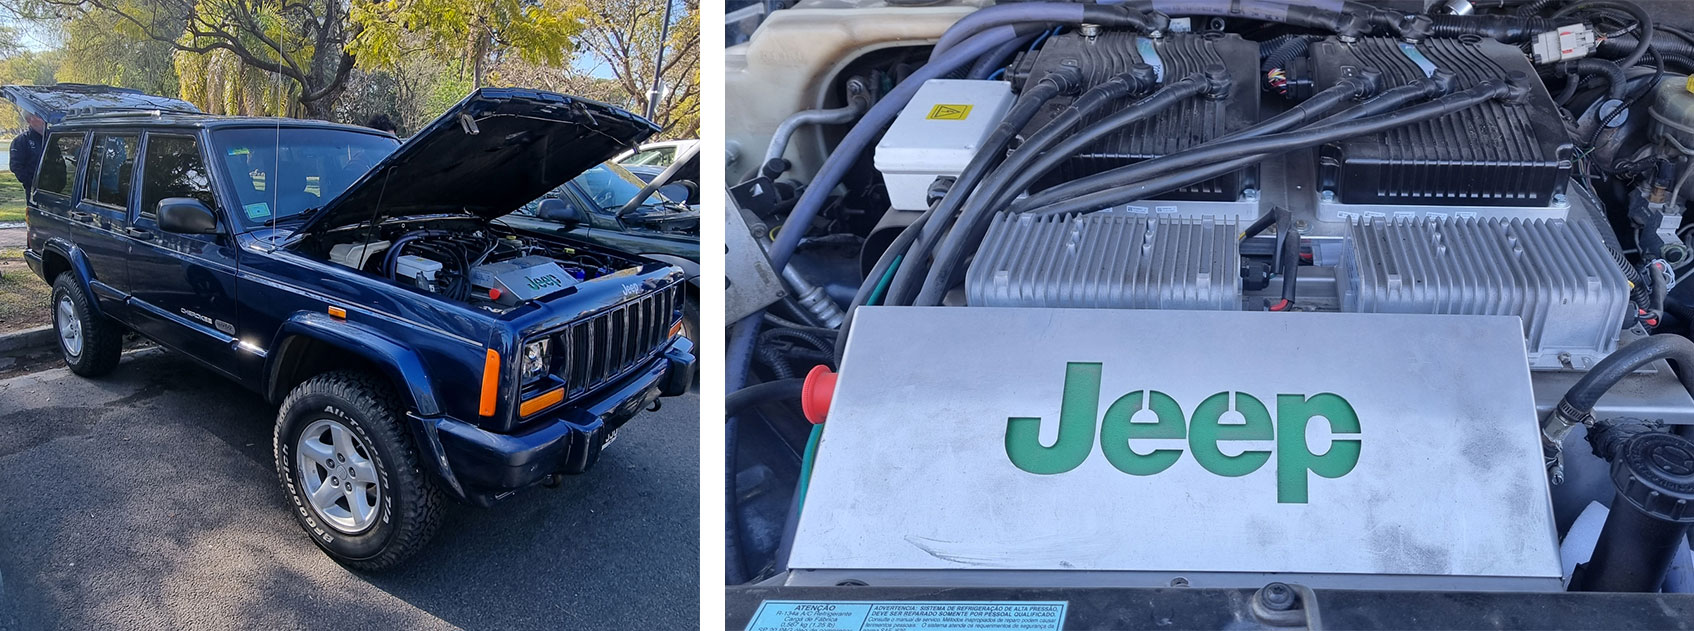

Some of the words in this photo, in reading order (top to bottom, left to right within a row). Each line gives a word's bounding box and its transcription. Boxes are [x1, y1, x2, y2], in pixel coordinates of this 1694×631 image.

[524, 274, 562, 291] Jeep
[622, 283, 640, 296] Jeep
[1004, 361, 1362, 504] Jeep
[382, 495, 392, 524] T/A
[794, 604, 836, 612] ATENÇÃO
